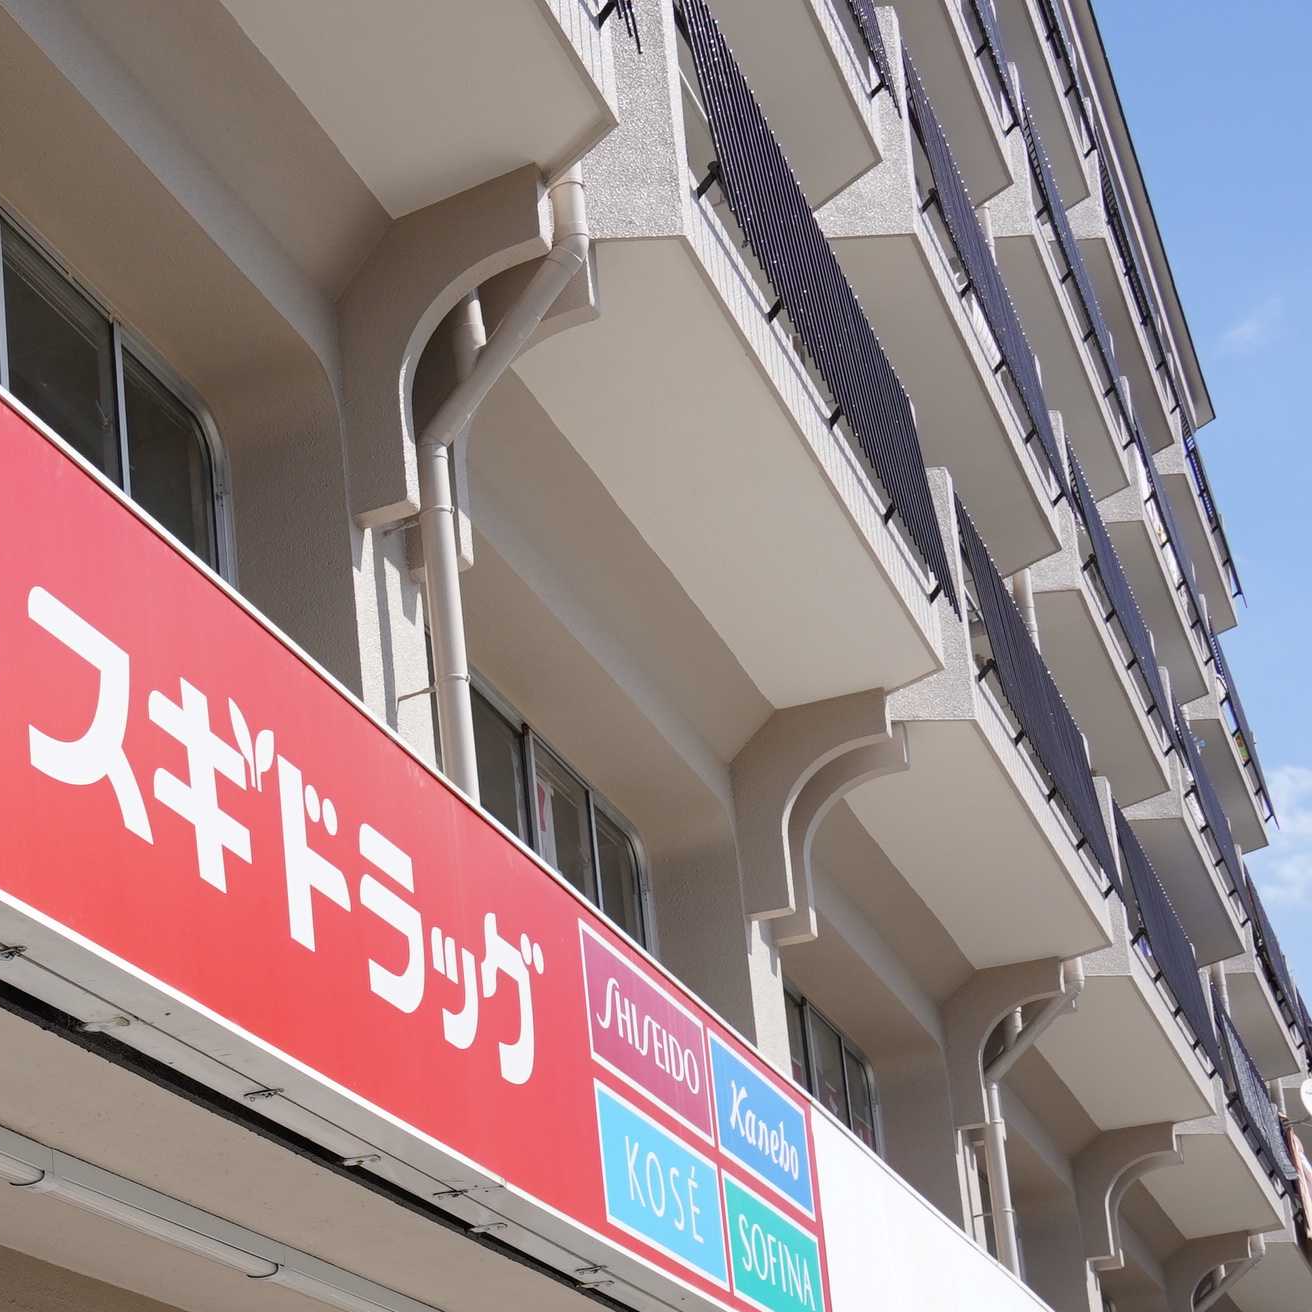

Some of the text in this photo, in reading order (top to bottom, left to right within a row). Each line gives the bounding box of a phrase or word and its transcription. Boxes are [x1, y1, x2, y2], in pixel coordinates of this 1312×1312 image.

[28, 586, 544, 1085] スギドラッグ
[596, 977, 700, 1095] SHISEIDO
[730, 1080, 800, 1181] Kanebo
[625, 1135, 704, 1244] KOSÉ
[739, 1213, 816, 1312] SOFINA
